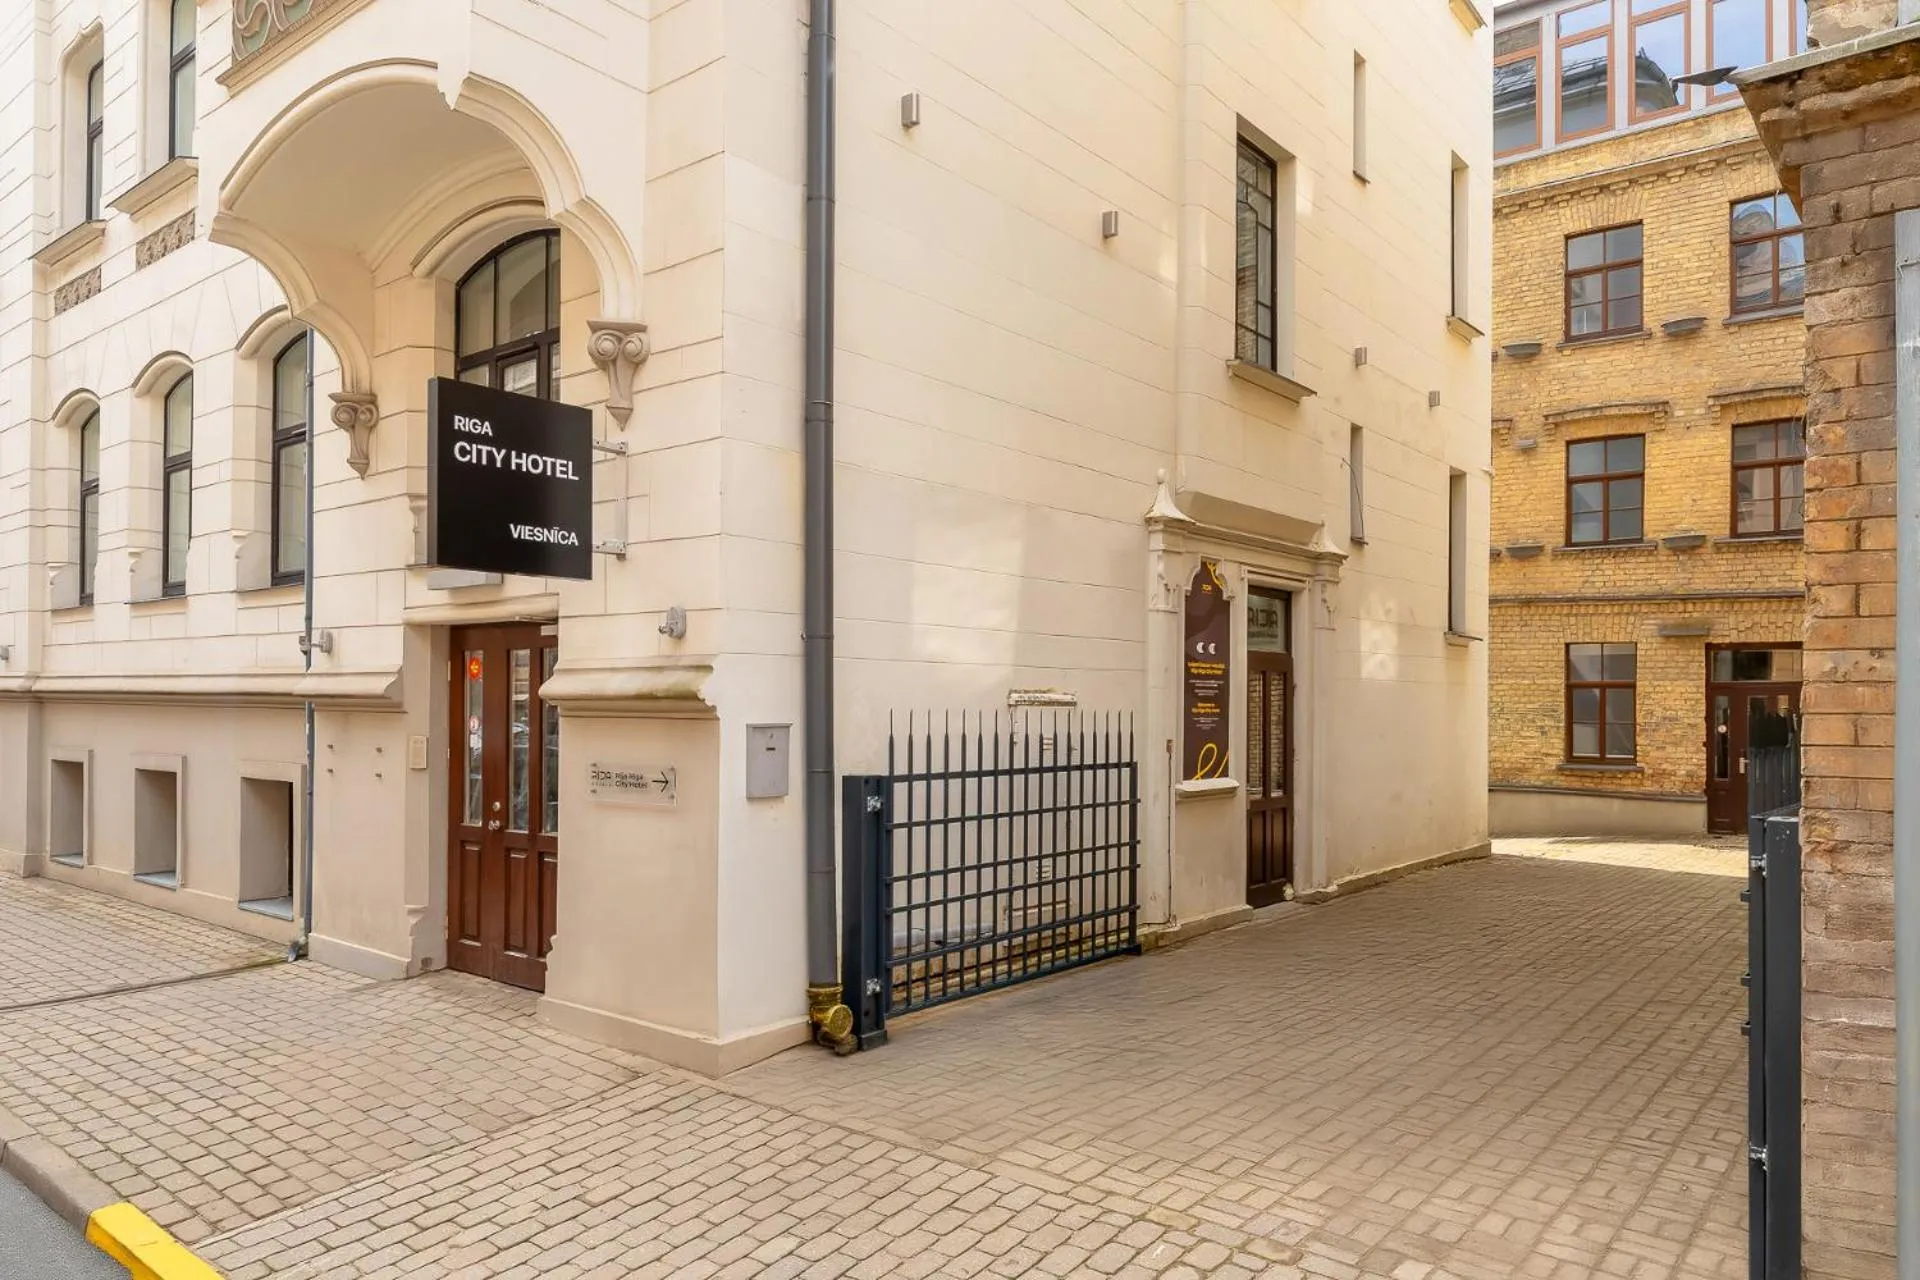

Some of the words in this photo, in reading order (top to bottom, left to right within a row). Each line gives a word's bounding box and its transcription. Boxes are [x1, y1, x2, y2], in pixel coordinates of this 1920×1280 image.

[453, 415, 493, 436] RIGA
[453, 441, 506, 468] CITY
[511, 450, 580, 481] HOTEL
[509, 523, 580, 546] VIESNĪCA
